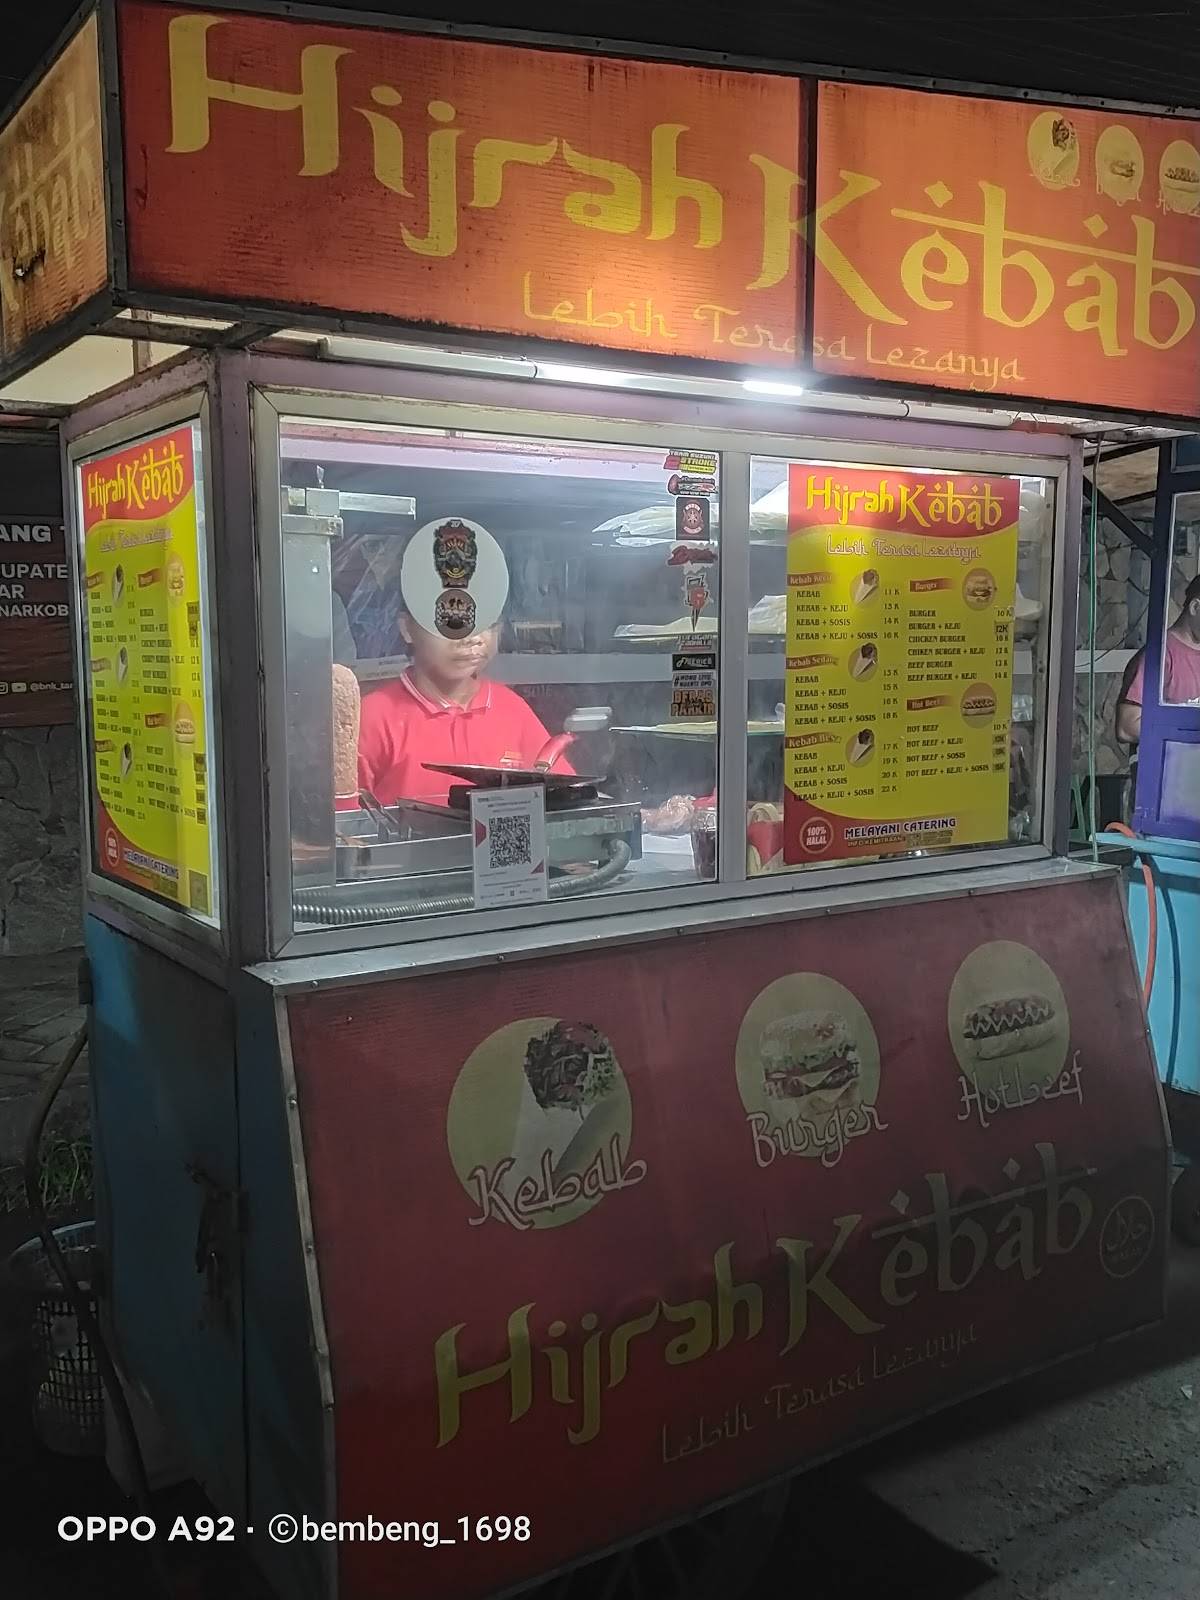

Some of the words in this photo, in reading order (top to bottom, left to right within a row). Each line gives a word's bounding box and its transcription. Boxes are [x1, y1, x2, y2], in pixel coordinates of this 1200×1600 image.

[165, 14, 724, 257] Hijrah
[746, 153, 1200, 356] Kebab
[523, 271, 678, 337] Lebih
[693, 304, 856, 360] Terasa
[867, 323, 1026, 392] Lezanya
[88, 463, 126, 520] Hijrah
[125, 440, 184, 510] Kebab
[806, 475, 894, 525] Hijrah
[897, 480, 1004, 530] Kebab
[827, 534, 868, 556] Lebih
[872, 537, 921, 558] Terasa
[797, 590, 820, 598] KEBAB
[830, 604, 848, 612] KEJU
[829, 618, 850, 626] SOSIS
[796, 632, 820, 640] KEBAB
[829, 632, 848, 640] KEJU
[857, 631, 878, 640] SOSIS
[908, 661, 925, 669] BEEF
[795, 676, 819, 684] KEBAB
[926, 673, 953, 681] BURGER
[795, 690, 819, 698] KEBAB
[828, 688, 847, 697] KEJU
[794, 704, 819, 712] KEBAB
[828, 702, 849, 710] SOSIS
[794, 717, 819, 725] KEBAB
[828, 716, 846, 724] KEJU
[855, 714, 876, 722] SOSIS
[906, 740, 920, 748] HOT
[794, 753, 818, 761] KEBAB
[946, 752, 966, 760] SOSIS
[794, 766, 817, 775] KEBAB
[827, 764, 845, 772] KEJU
[794, 780, 817, 788] KEBAB
[827, 777, 847, 785] SOSIS
[827, 791, 845, 799] KEJU
[854, 788, 874, 796] SOSIS
[807, 826, 827, 836] 100%
[845, 823, 900, 838] MELAYANI
[904, 818, 956, 833] CATERING
[806, 836, 827, 846] HALAL
[746, 1101, 888, 1168] Burger
[467, 1134, 648, 1231] Kebab
[433, 1239, 764, 1448] Hijrah
[775, 1142, 1098, 1358] Kebab
[662, 1401, 754, 1464] Lebih
[764, 1365, 865, 1420] Terasa
